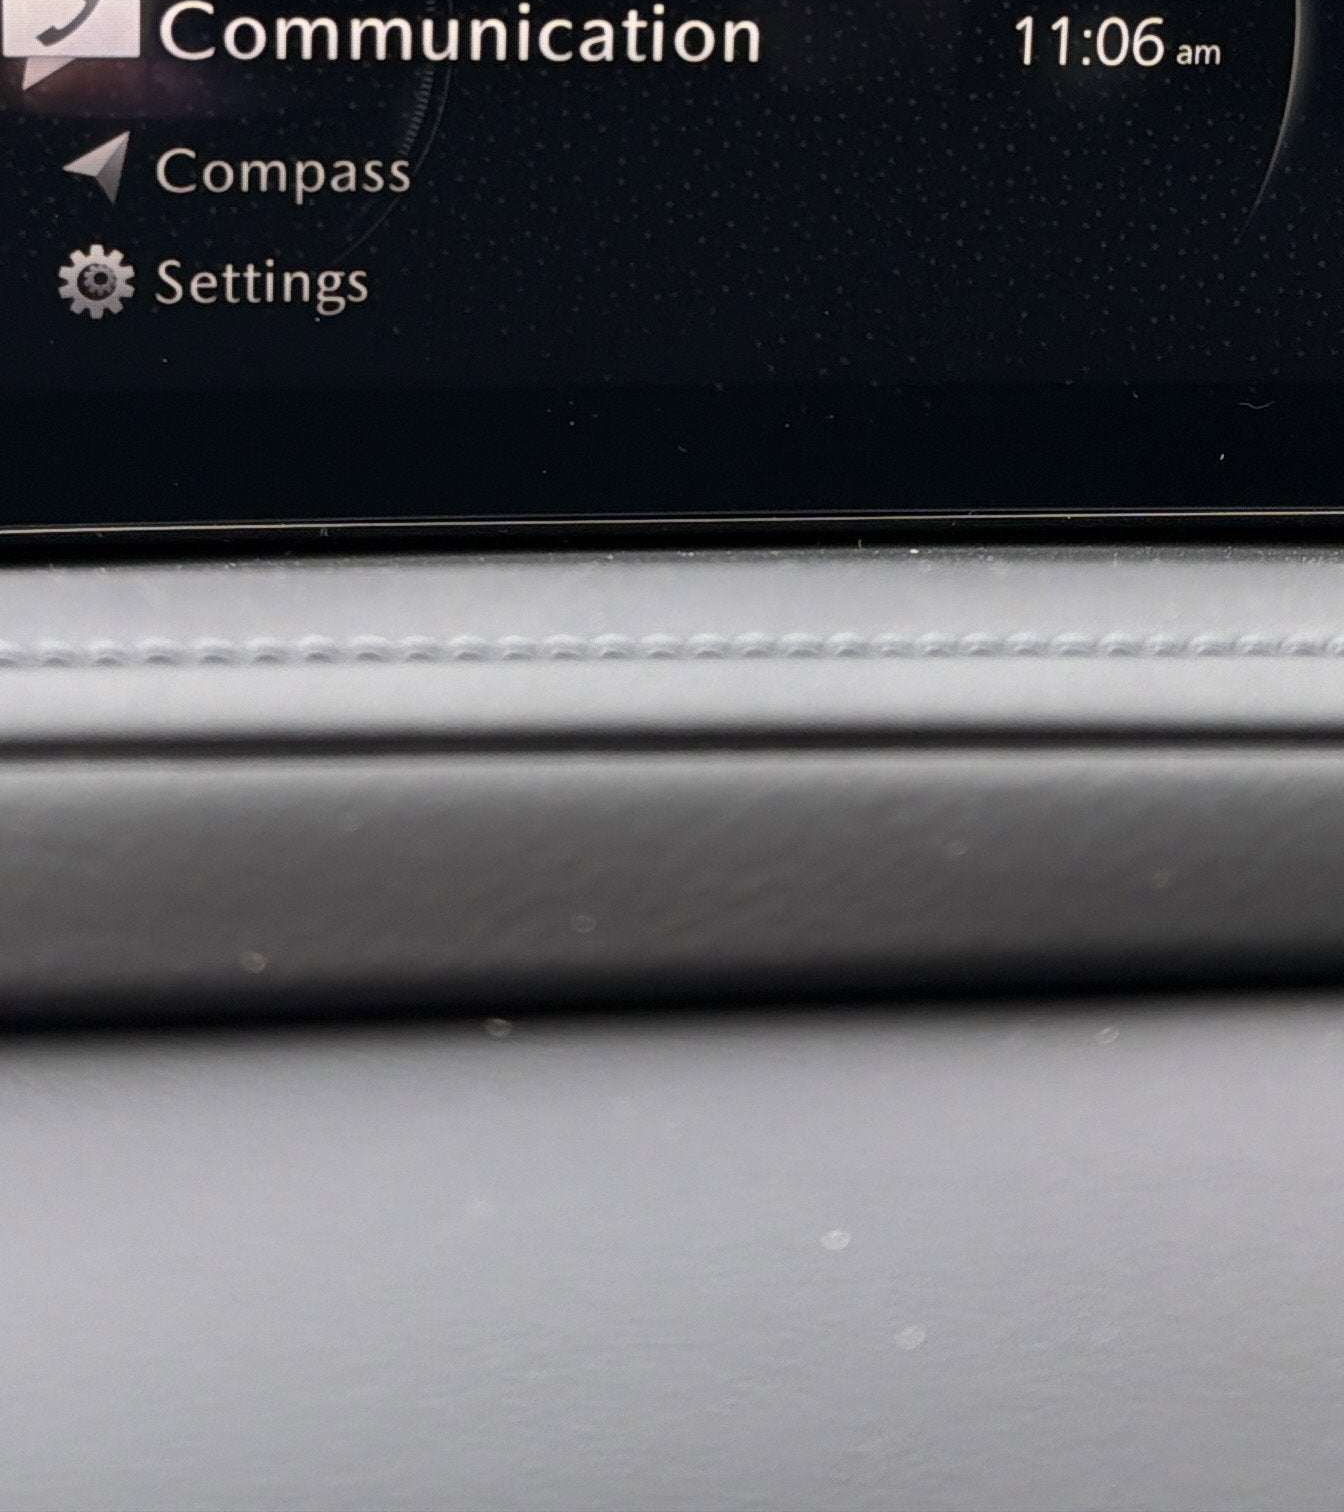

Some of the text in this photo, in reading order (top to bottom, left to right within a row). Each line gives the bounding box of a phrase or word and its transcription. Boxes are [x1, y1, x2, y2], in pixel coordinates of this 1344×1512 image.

[158, 0, 761, 63] Communication
[1014, 15, 1222, 67] 11:06 am
[156, 147, 411, 205] Compass
[155, 258, 369, 316] Settings
